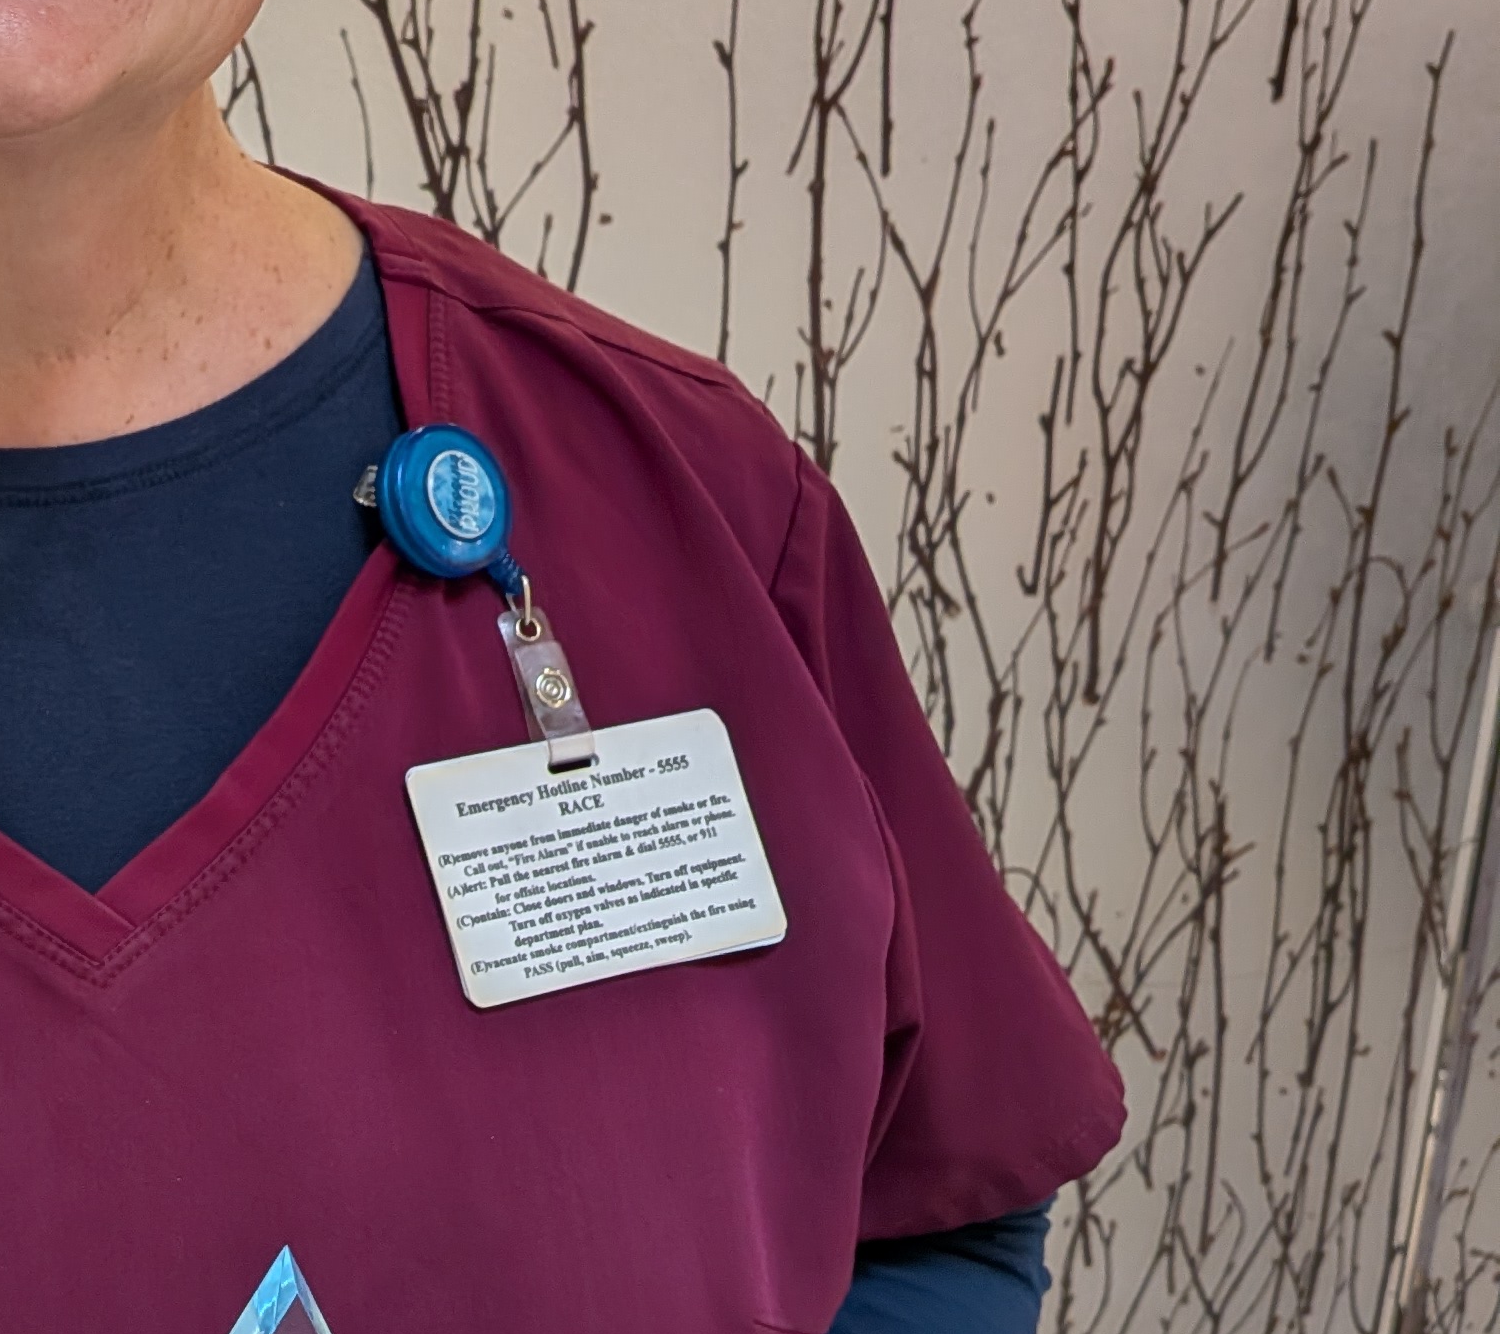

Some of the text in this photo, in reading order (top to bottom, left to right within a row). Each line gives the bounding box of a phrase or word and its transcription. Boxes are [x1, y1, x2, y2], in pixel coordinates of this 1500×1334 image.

[458, 460, 479, 531] PROUD
[455, 791, 533, 817] Emergency
[535, 779, 588, 799] Hotline
[588, 766, 645, 788] Number
[656, 754, 689, 774] 5555
[557, 793, 604, 816] RACE
[437, 848, 488, 867] (R)emove
[490, 839, 528, 854] anyone
[529, 833, 556, 846] from
[556, 820, 611, 840] immediate
[613, 812, 648, 827] danger
[650, 806, 661, 819] of
[662, 801, 695, 816] smoke
[696, 798, 707, 809] or
[463, 862, 486, 876] Call
[575, 839, 584, 852] if
[585, 833, 618, 849] unable
[619, 832, 630, 841] to
[632, 823, 659, 839] reach
[660, 819, 689, 832] alarm
[691, 816, 702, 825] or
[488, 872, 511, 888] Pull
[512, 870, 530, 882] the
[531, 860, 570, 878] nearest
[570, 856, 590, 869] fire
[591, 850, 623, 864] alarm
[624, 844, 635, 856] &
[636, 839, 657, 853] dial
[657, 833, 686, 849] 5555,
[686, 832, 698, 842] or
[699, 826, 717, 839] 911
[494, 874, 596, 904] for offsite locations.
[507, 869, 738, 931] Turn off oxygen valves as indicated in specific
[512, 900, 542, 914] Close
[543, 893, 574, 907] doors
[575, 885, 595, 900] and
[644, 870, 672, 883] Turn
[673, 863, 688, 877] off
[689, 853, 745, 874] equipment.
[514, 919, 604, 947] department plan.
[529, 943, 563, 959] smoke
[689, 909, 706, 920] the
[707, 905, 726, 916] fire
[727, 897, 756, 911] using
[523, 961, 554, 978] PASS
[585, 950, 609, 963] aim,
